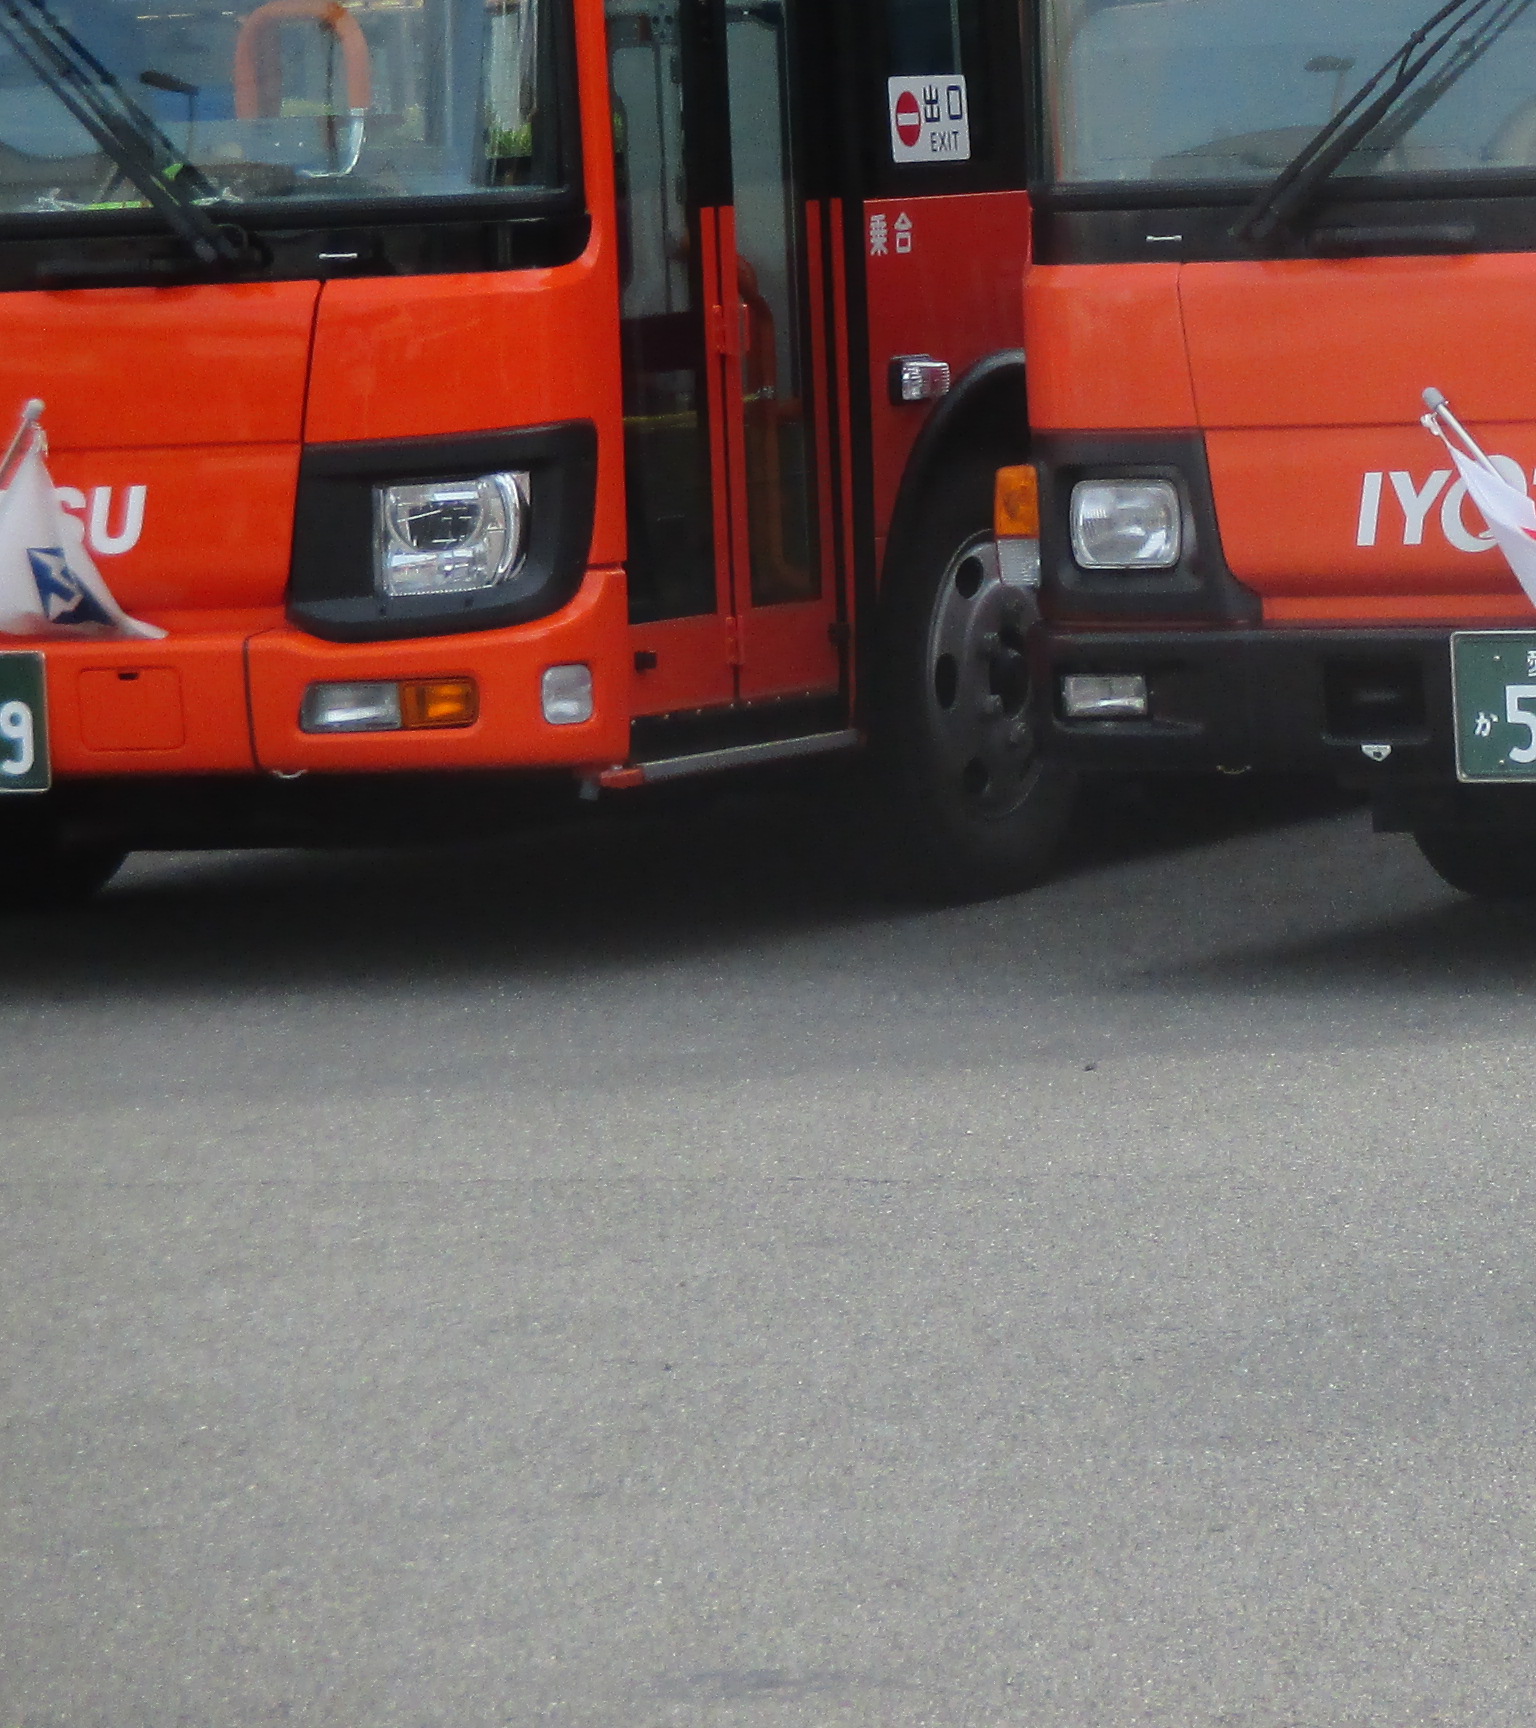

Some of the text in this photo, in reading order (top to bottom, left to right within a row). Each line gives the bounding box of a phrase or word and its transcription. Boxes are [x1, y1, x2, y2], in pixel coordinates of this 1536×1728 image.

[922, 84, 963, 123] 出口
[929, 131, 960, 152] EXIT
[869, 211, 913, 256] 乗合
[1472, 712, 1499, 738] か
